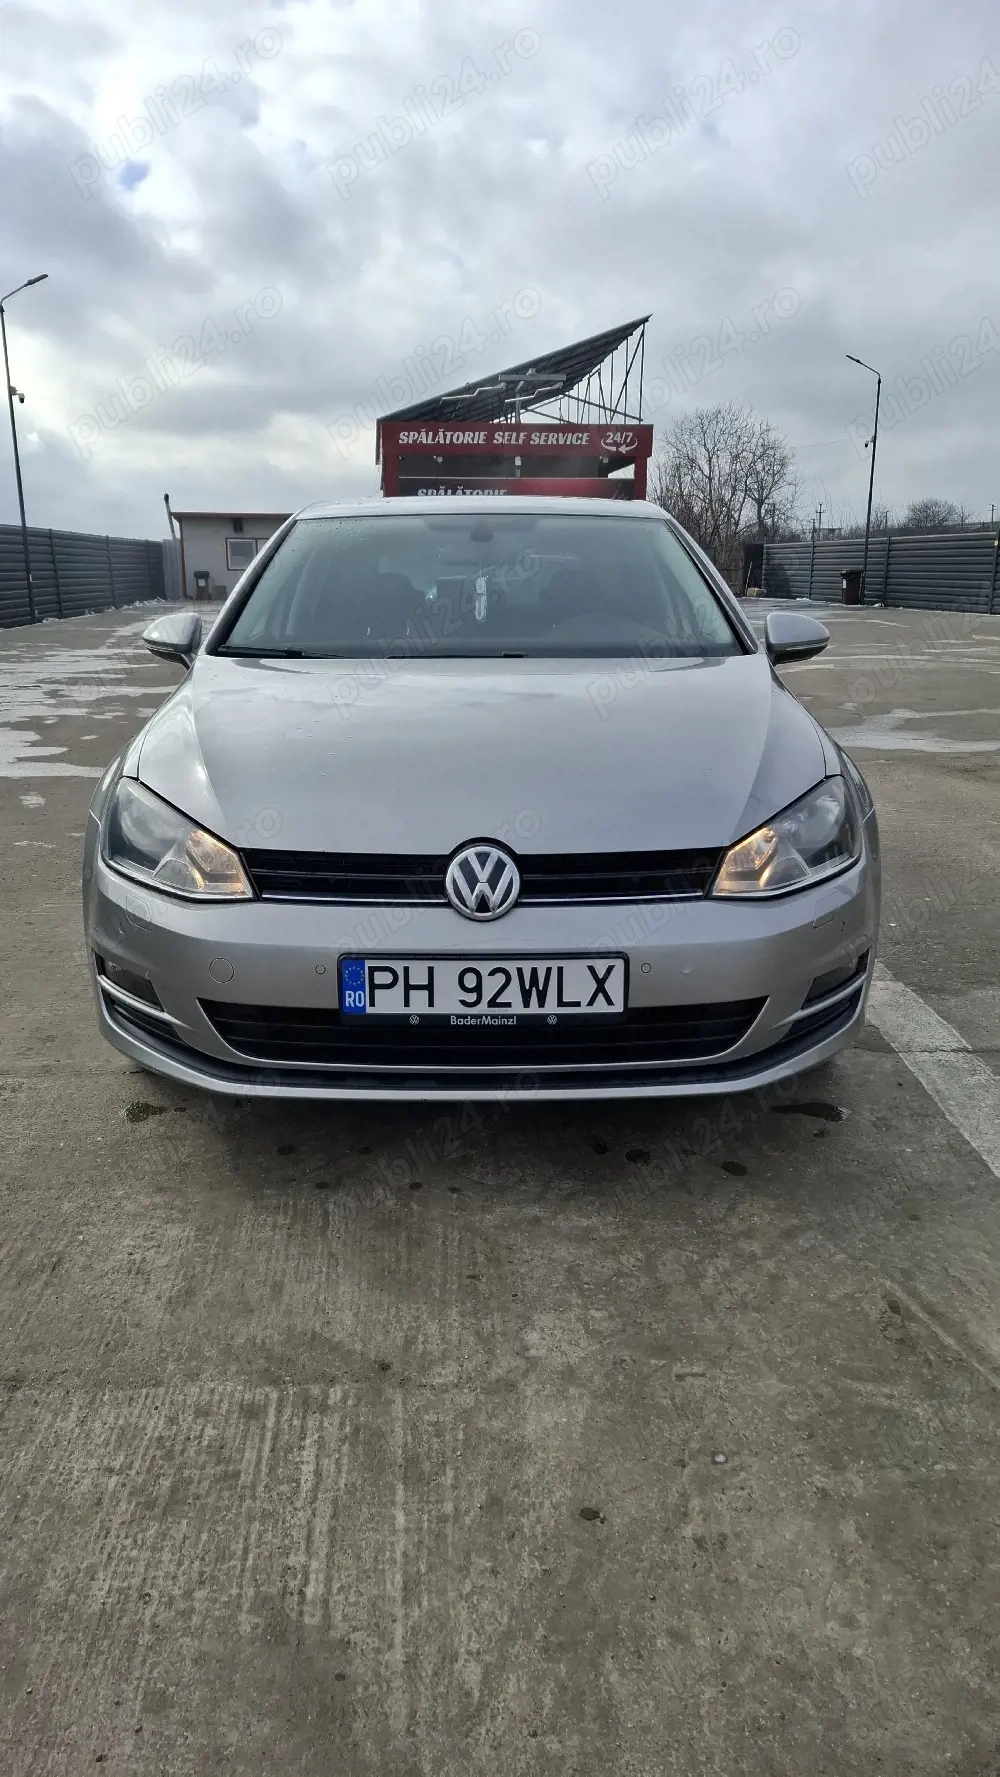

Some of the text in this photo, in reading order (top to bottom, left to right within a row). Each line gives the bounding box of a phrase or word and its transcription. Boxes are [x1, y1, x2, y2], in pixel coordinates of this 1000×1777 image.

[398, 428, 633, 445] SPĂLĂTORIE SELF SERVICE 24/7
[345, 964, 616, 1008] RO PH 92WLX
[450, 1015, 517, 1025] BaderMainzl
